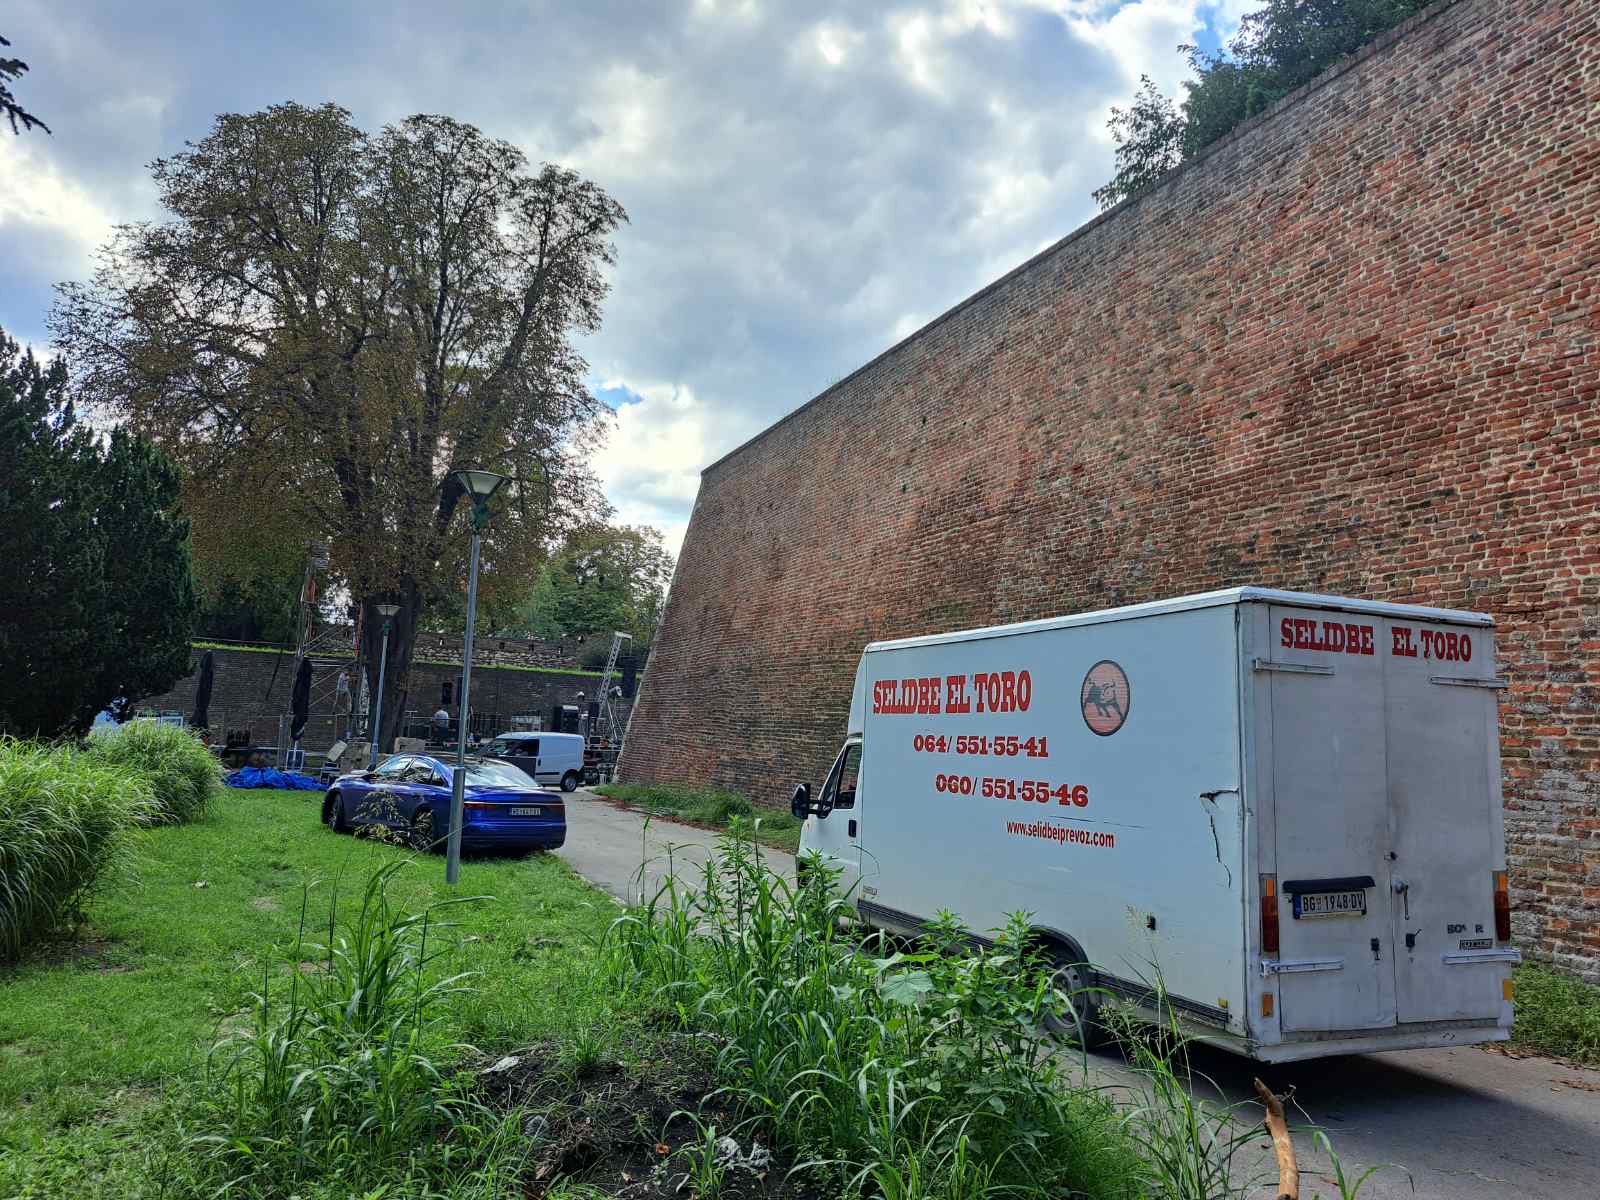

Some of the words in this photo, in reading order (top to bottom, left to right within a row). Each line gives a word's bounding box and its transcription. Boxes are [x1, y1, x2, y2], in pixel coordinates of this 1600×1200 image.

[1280, 617, 1375, 656] SELIDBE
[1391, 626, 1418, 657] EL
[1420, 629, 1472, 662] TORO
[873, 678, 941, 714] SELIDBE
[946, 675, 970, 713] EL
[974, 670, 1032, 713] TORO
[1006, 820, 1115, 848] www.selidbeiprevoz.com
[1303, 896, 1316, 911] BG
